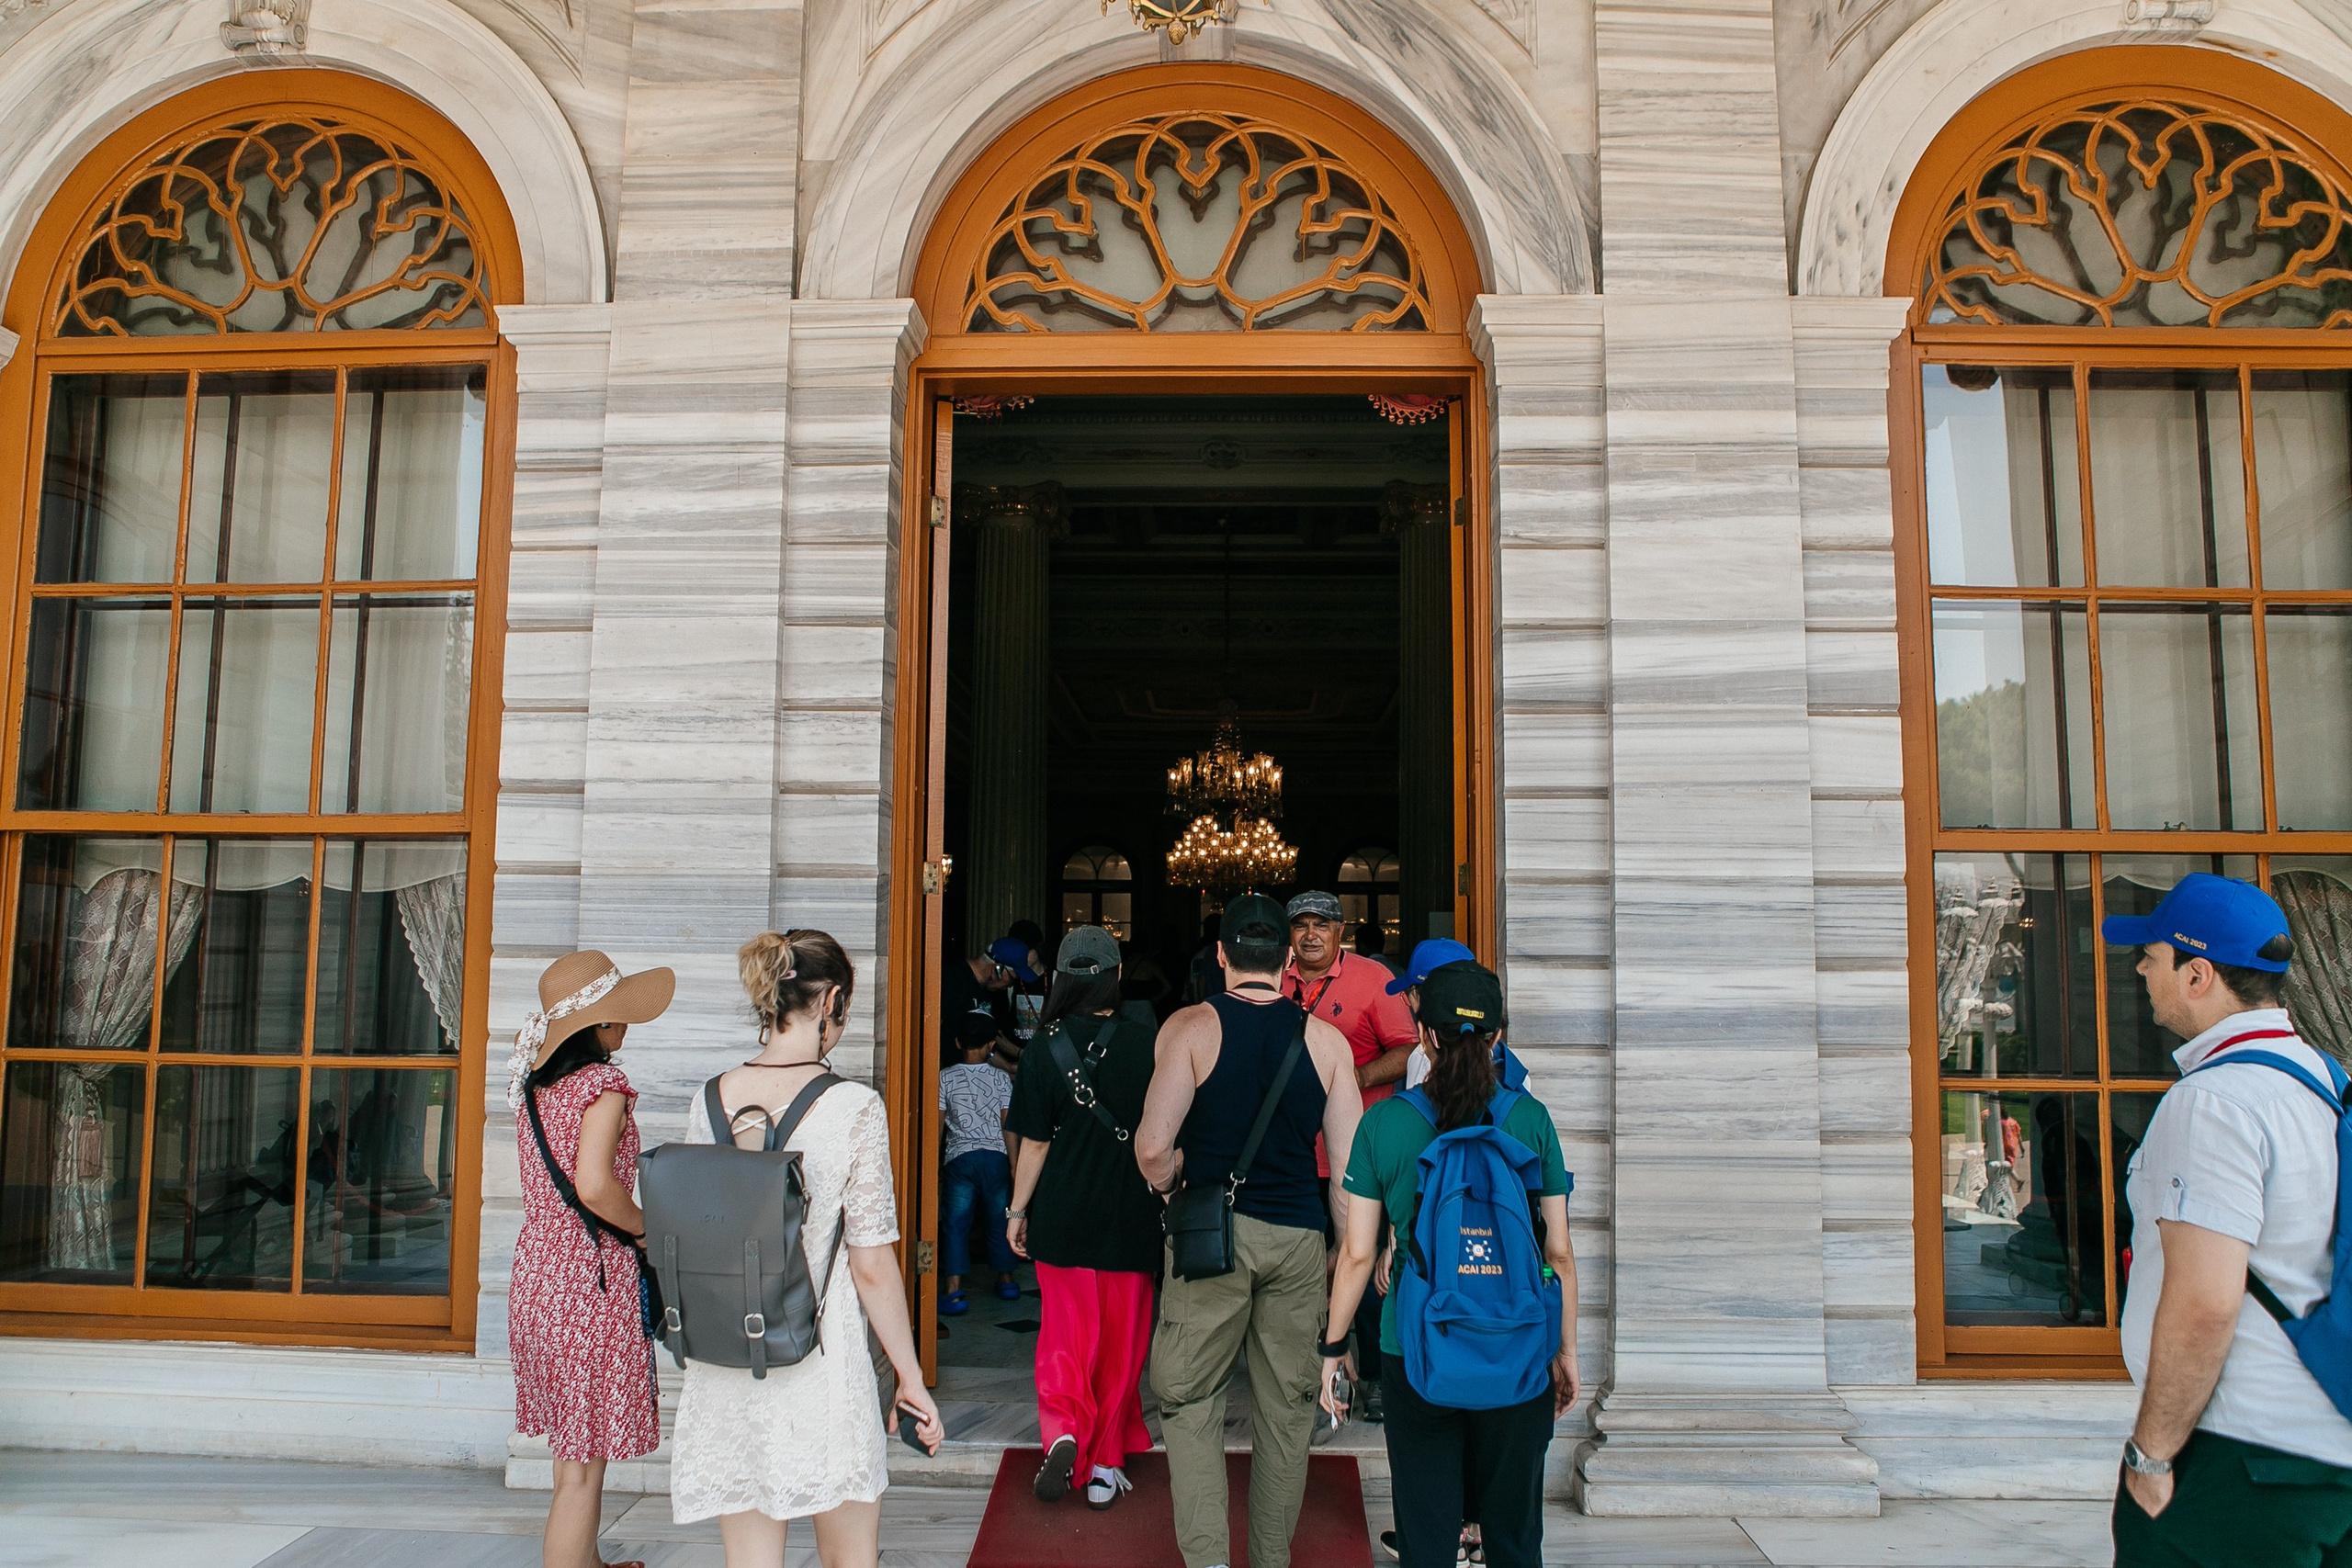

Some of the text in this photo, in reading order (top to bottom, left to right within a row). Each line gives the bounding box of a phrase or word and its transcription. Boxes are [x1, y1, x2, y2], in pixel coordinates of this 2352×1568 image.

[2174, 931, 2207, 950] ACAI 2023
[1460, 1225, 1492, 1236] Istanbul
[1457, 1264, 1502, 1275] ACAI 2023
